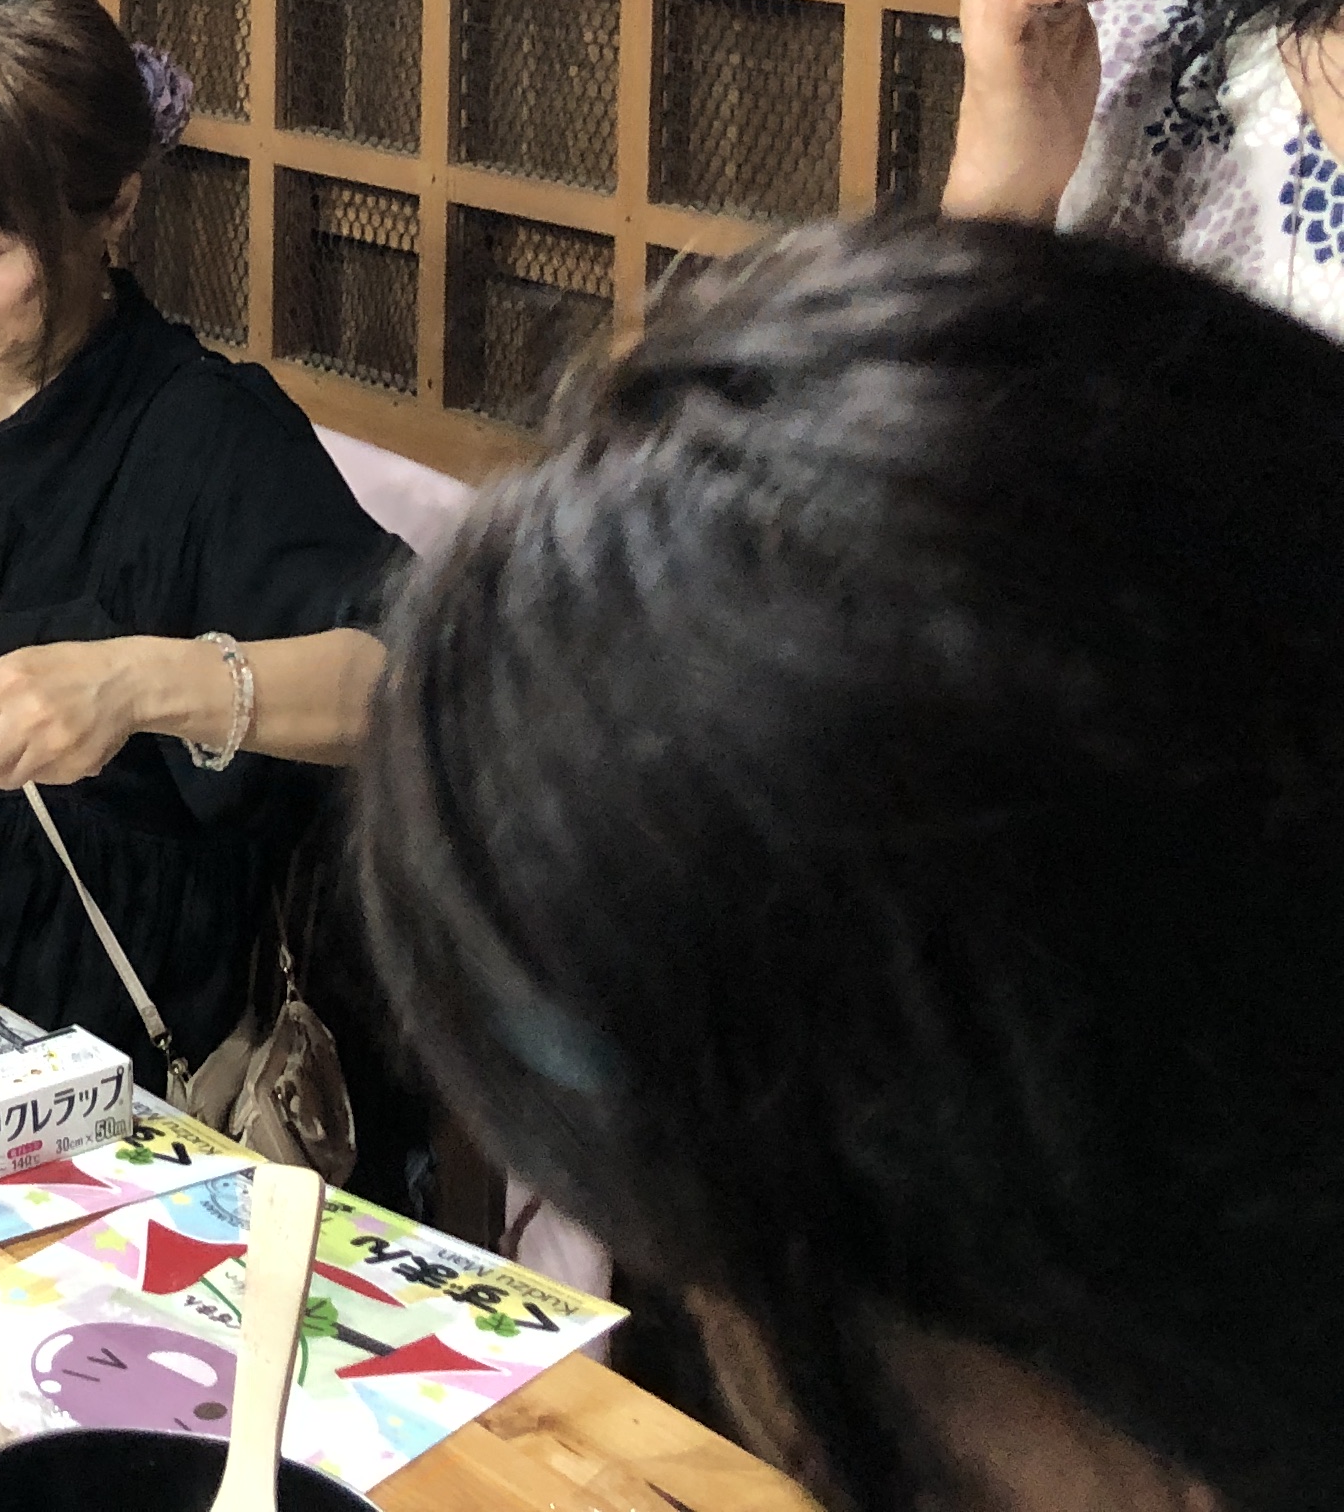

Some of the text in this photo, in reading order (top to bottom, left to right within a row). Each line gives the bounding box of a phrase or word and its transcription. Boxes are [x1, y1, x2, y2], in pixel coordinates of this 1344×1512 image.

[5, 1065, 125, 1142] クレラップ
[350, 1235, 560, 1333] くずまん
[437, 1247, 579, 1317] Kudzu Man
